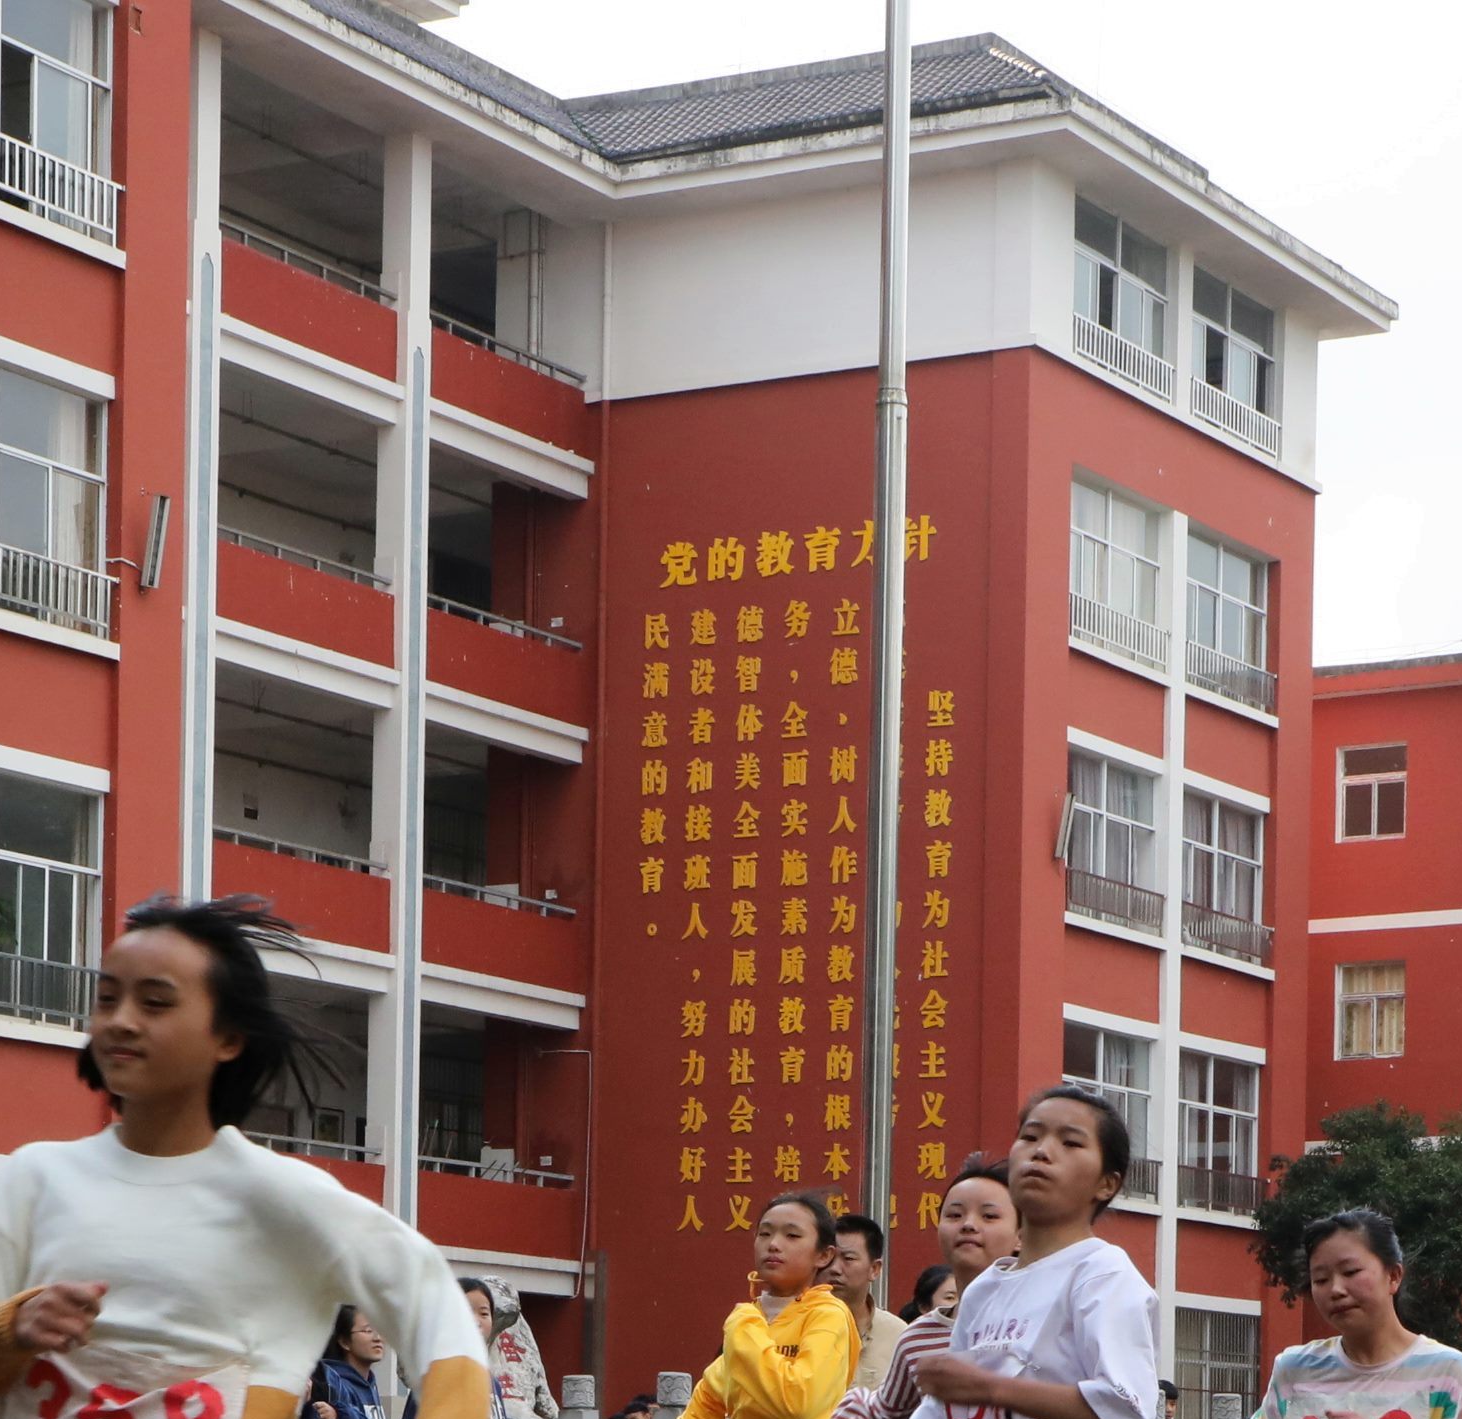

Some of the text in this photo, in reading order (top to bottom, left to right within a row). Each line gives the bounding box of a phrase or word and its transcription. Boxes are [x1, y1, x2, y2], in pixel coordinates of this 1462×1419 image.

[639, 613, 669, 938] 民满意的教育。
[724, 605, 763, 1233] 德智体美全面发展的社会主义
